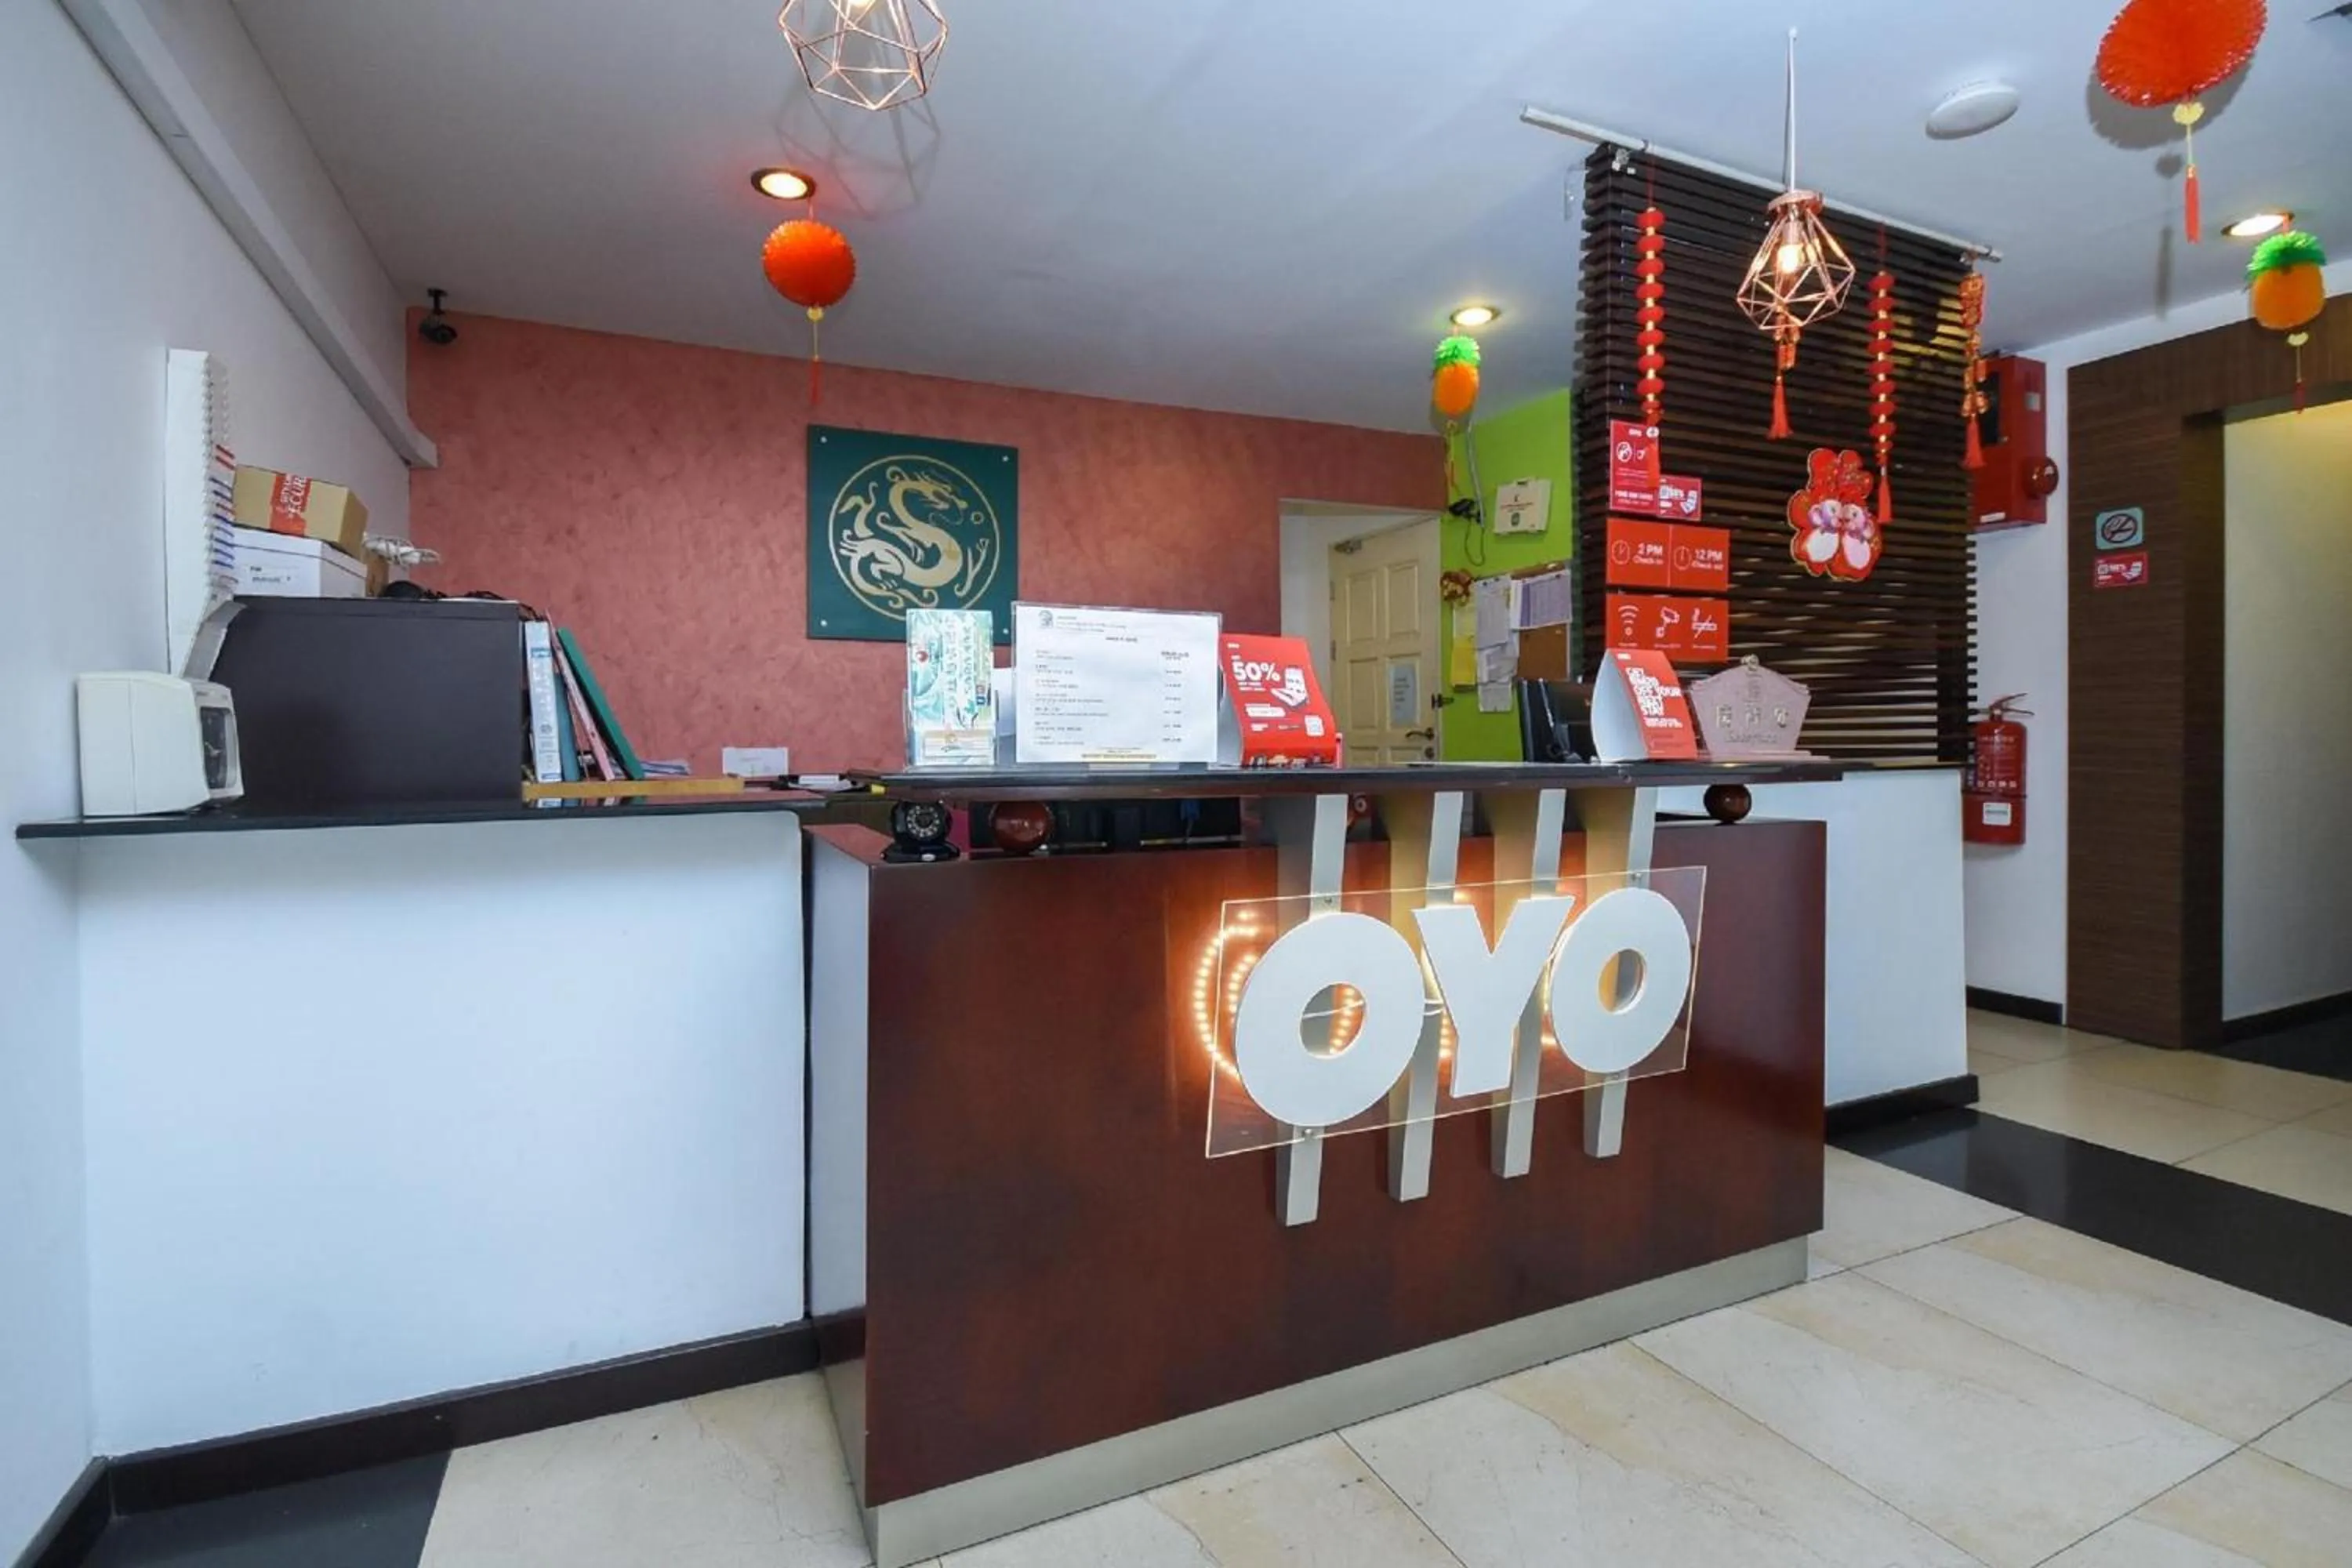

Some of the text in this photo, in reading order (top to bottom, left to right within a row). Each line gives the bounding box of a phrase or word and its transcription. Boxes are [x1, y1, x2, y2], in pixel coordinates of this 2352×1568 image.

[1638, 543, 1663, 556] 2 PM
[1707, 550, 1722, 561] PM
[1232, 661, 1281, 682] 50%
[1235, 887, 1692, 1127] OYO
